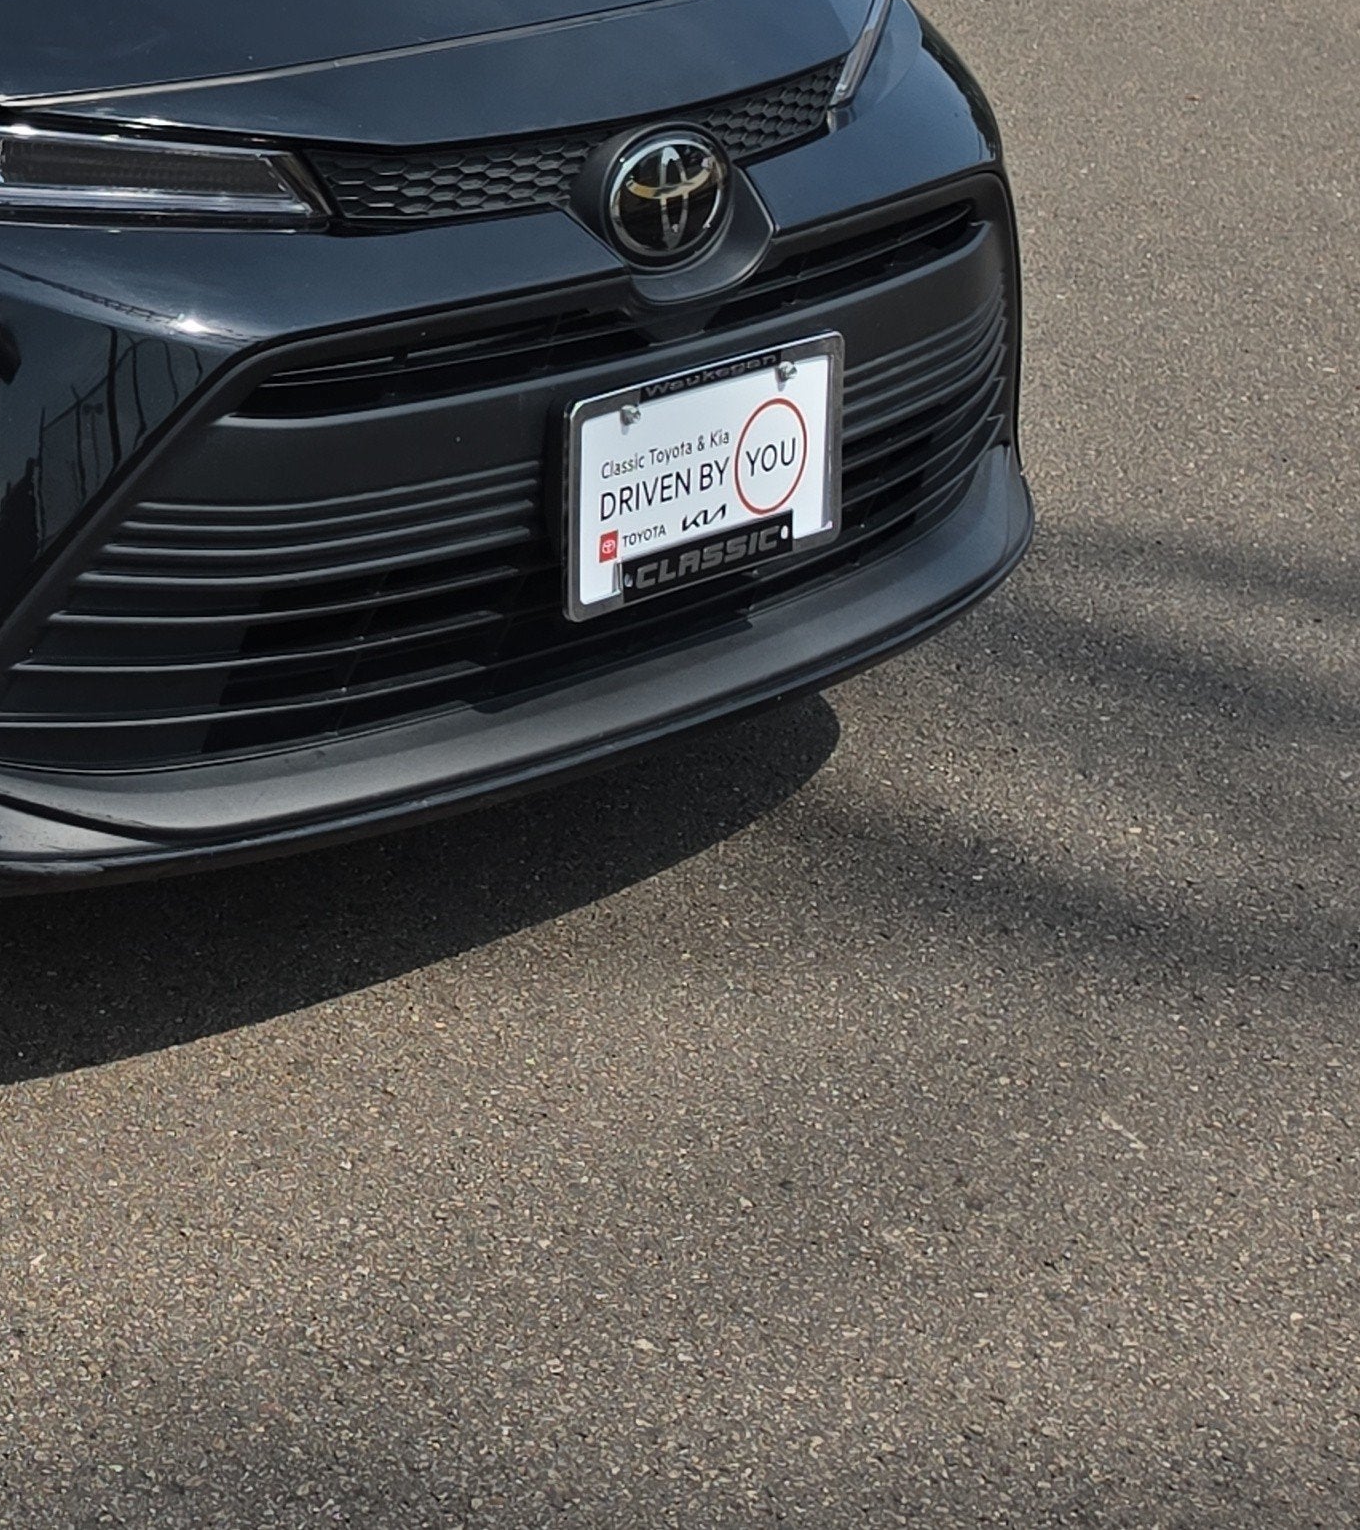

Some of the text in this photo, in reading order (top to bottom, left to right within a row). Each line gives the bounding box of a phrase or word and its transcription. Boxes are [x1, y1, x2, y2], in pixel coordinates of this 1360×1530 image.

[600, 428, 730, 479] Classic Toyota & Kia
[600, 437, 797, 522] DRIVEN BY YOU
[622, 524, 668, 548] TOYOTA
[635, 524, 780, 590] CLASSIC
